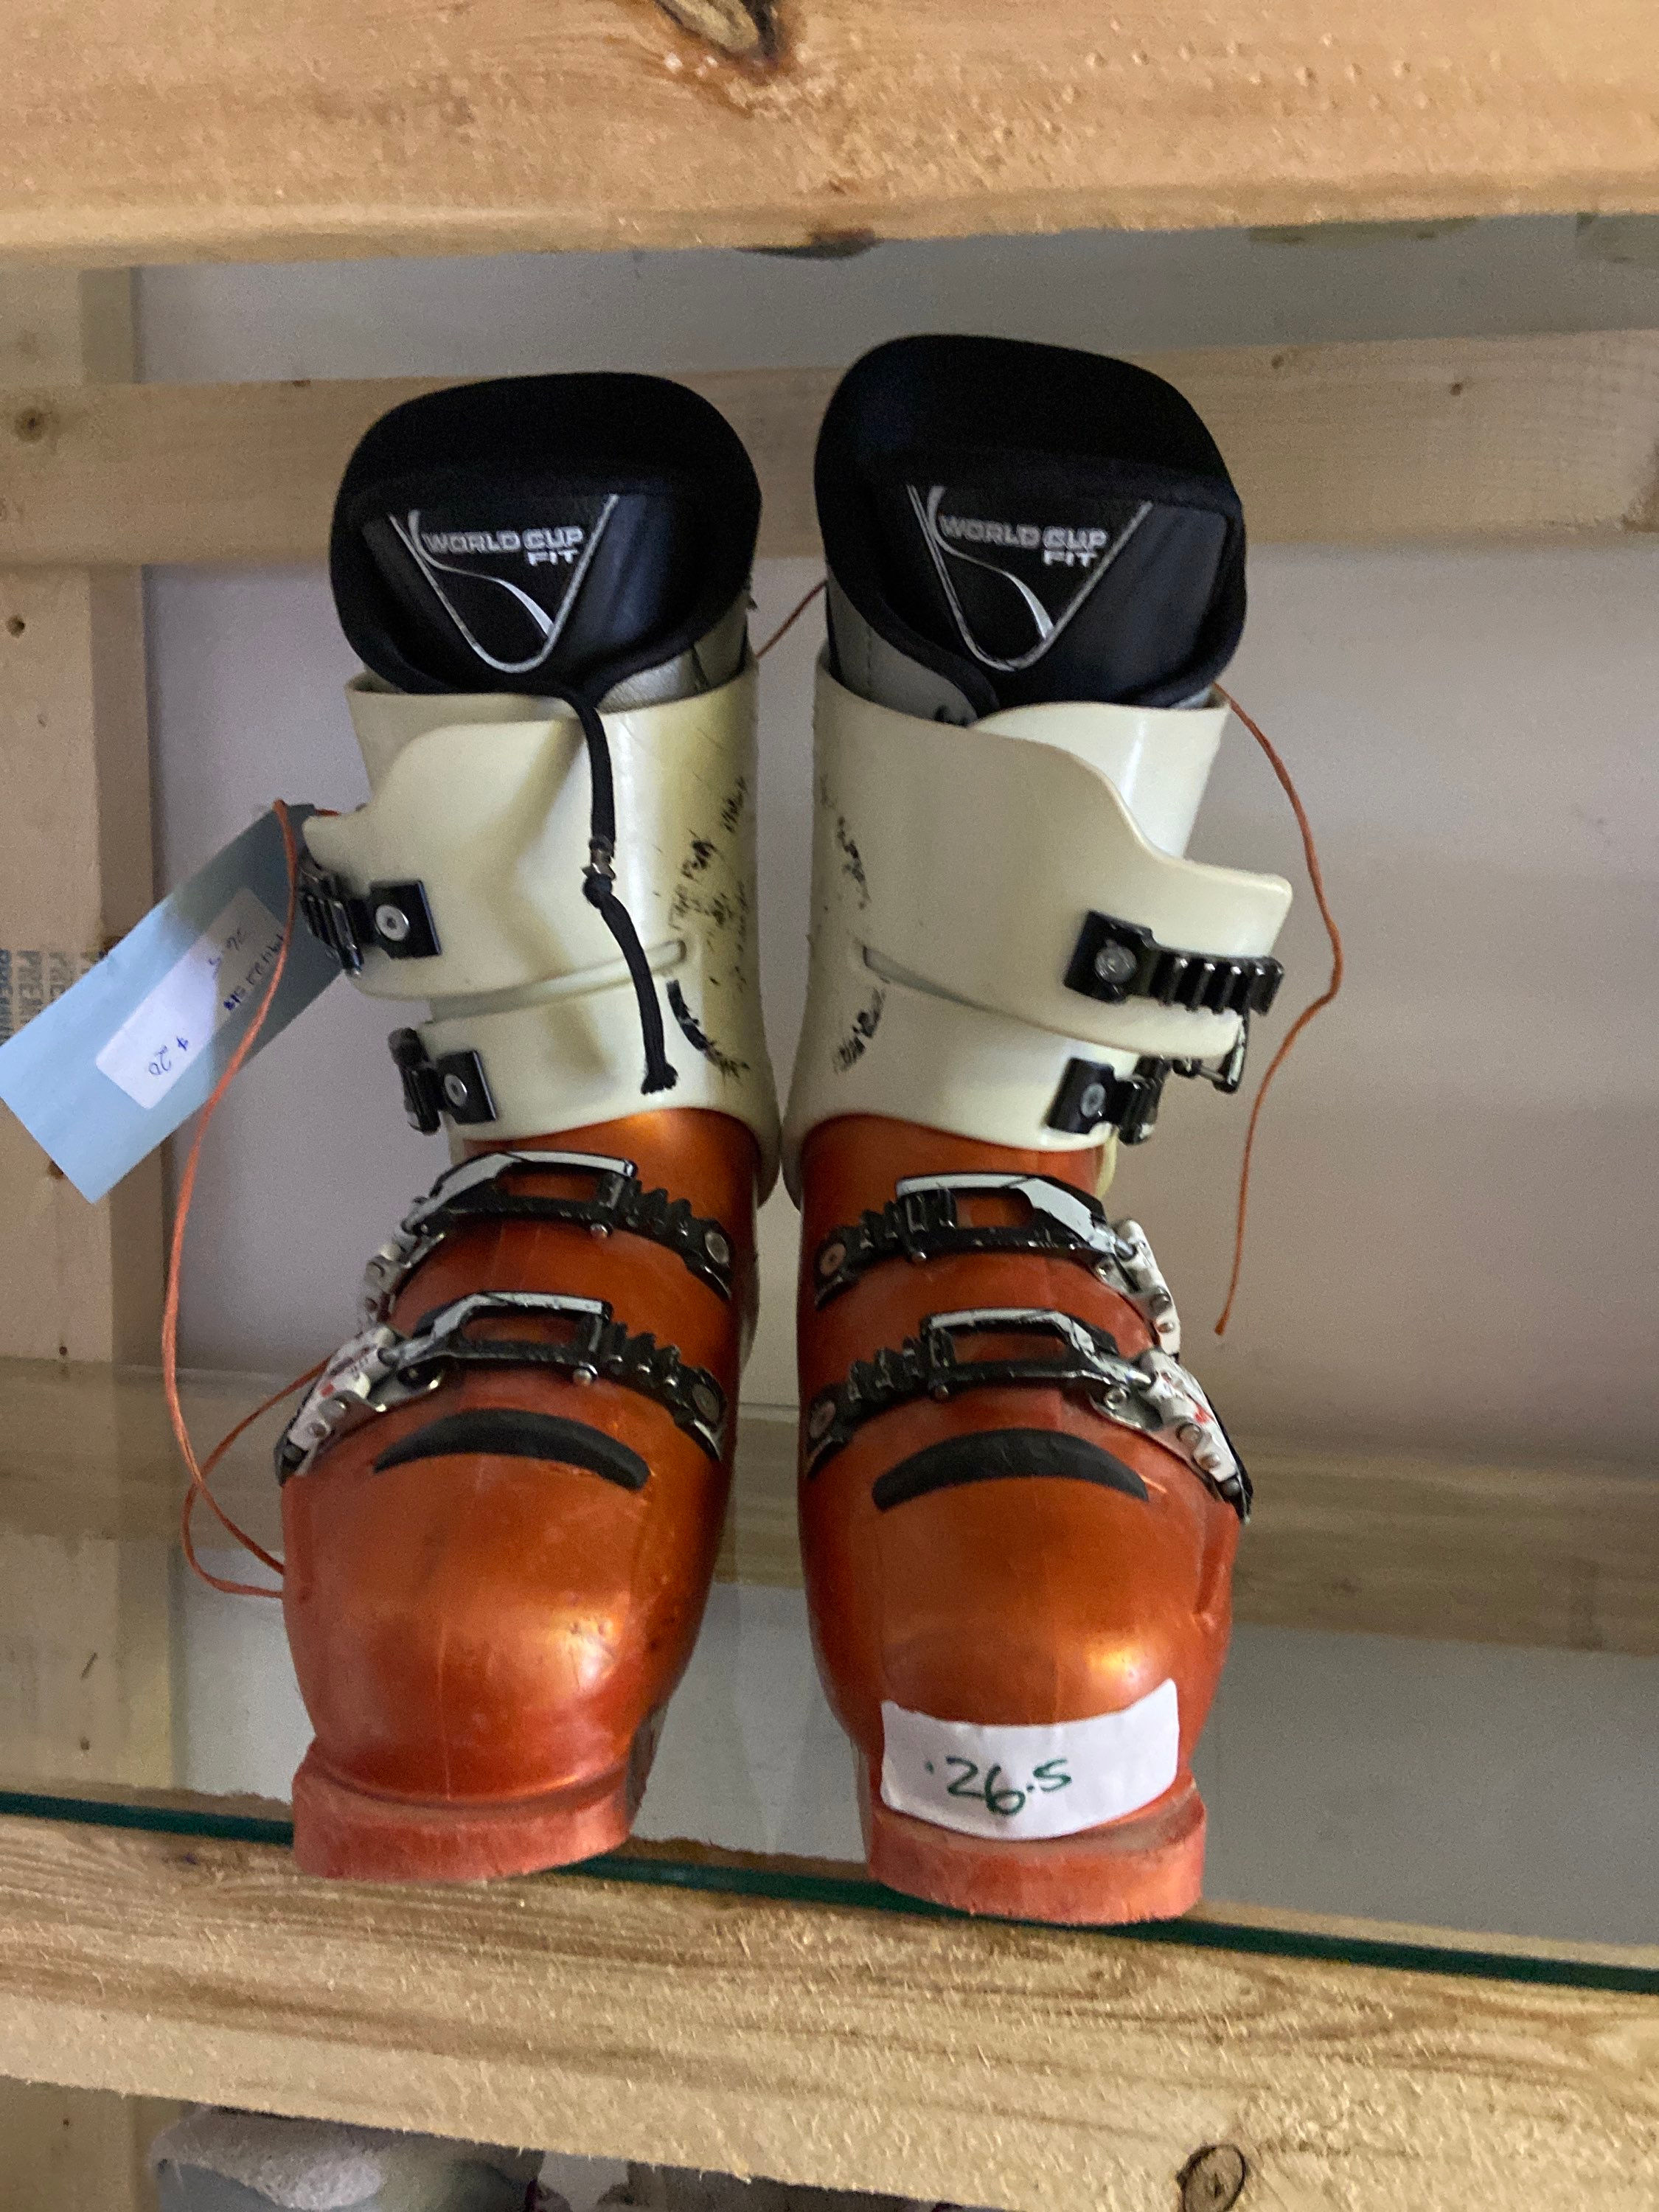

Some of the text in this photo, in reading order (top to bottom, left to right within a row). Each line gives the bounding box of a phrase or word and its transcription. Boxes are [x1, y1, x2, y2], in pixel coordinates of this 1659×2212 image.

[421, 526, 584, 554] WORLD CUP
[939, 515, 1109, 552] WORLD CUP
[526, 549, 580, 567] FIT
[1043, 549, 1098, 567] FIT
[148, 1044, 172, 1076] 20
[945, 1756, 1073, 1816] 26.5
